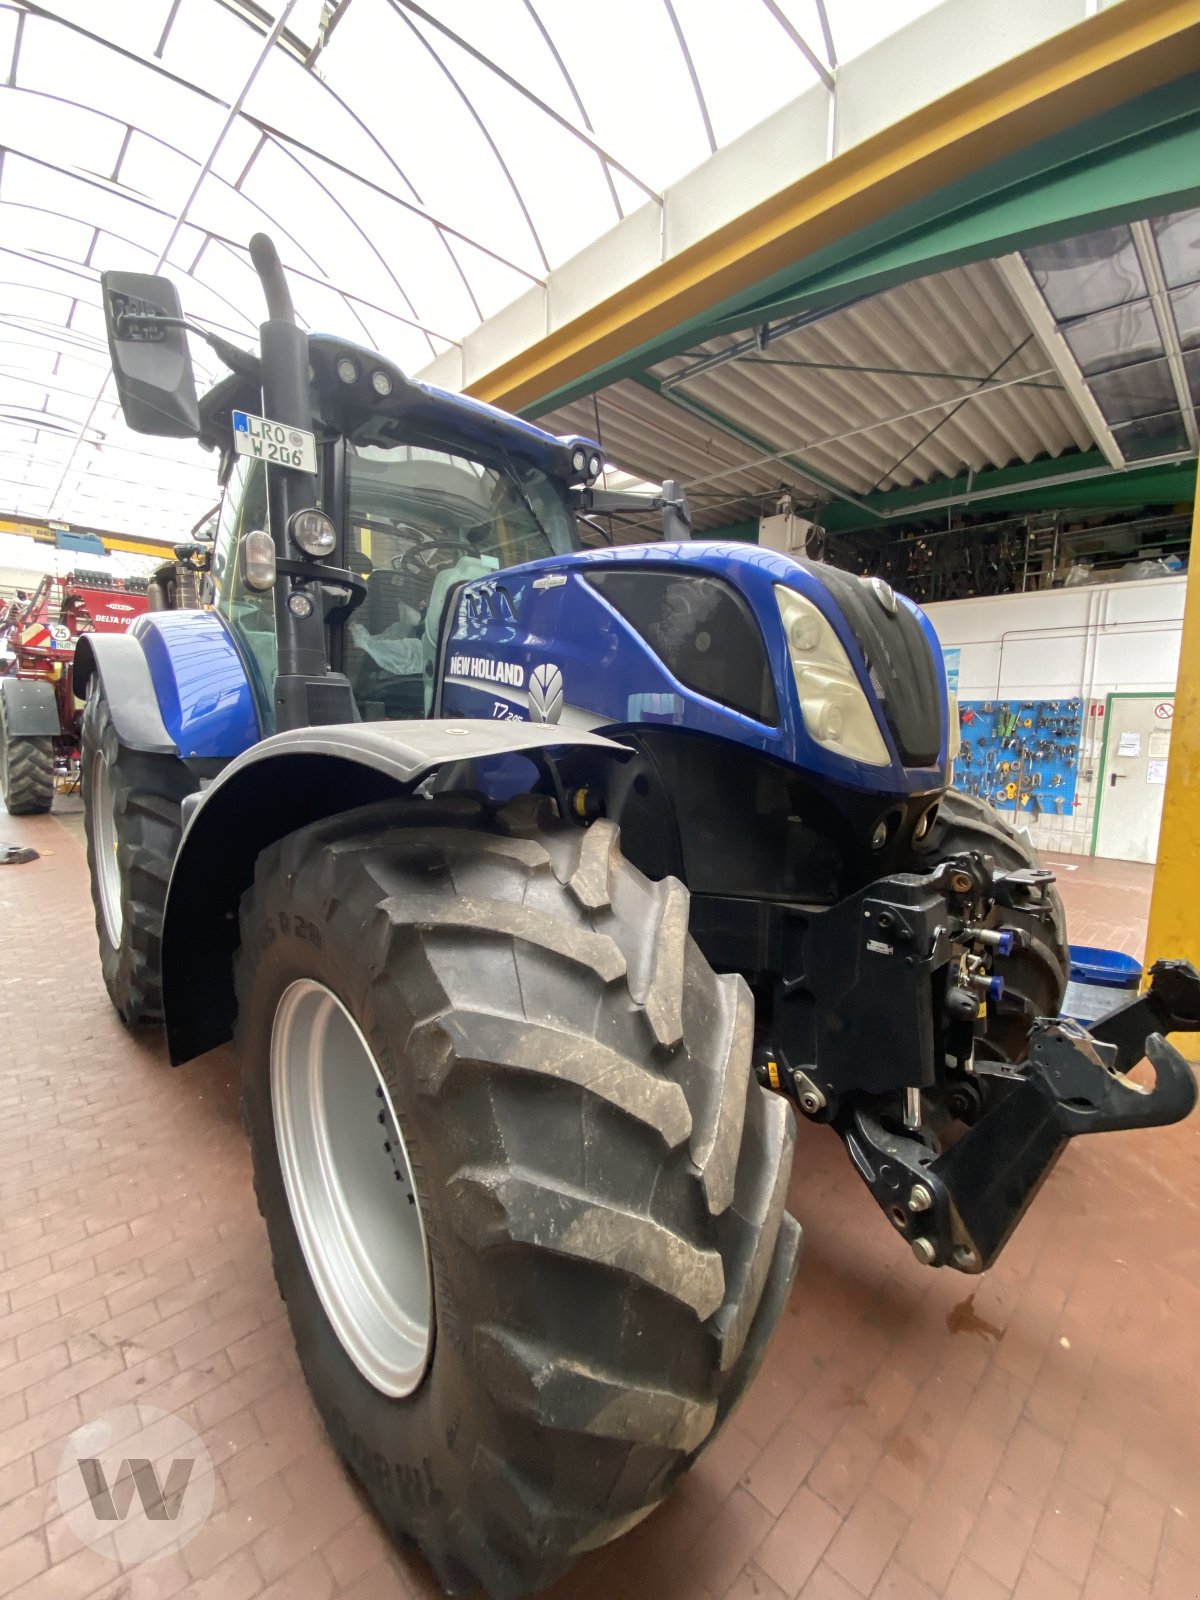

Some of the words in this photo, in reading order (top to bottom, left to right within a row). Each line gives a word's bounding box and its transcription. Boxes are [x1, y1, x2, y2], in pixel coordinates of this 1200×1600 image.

[248, 418, 285, 444] LRO
[251, 437, 262, 457] W
[267, 442, 301, 467] 206
[95, 614, 119, 624] DELTA
[55, 627, 66, 639] 25
[450, 656, 470, 676] NEW
[470, 657, 524, 687] HOLLAND
